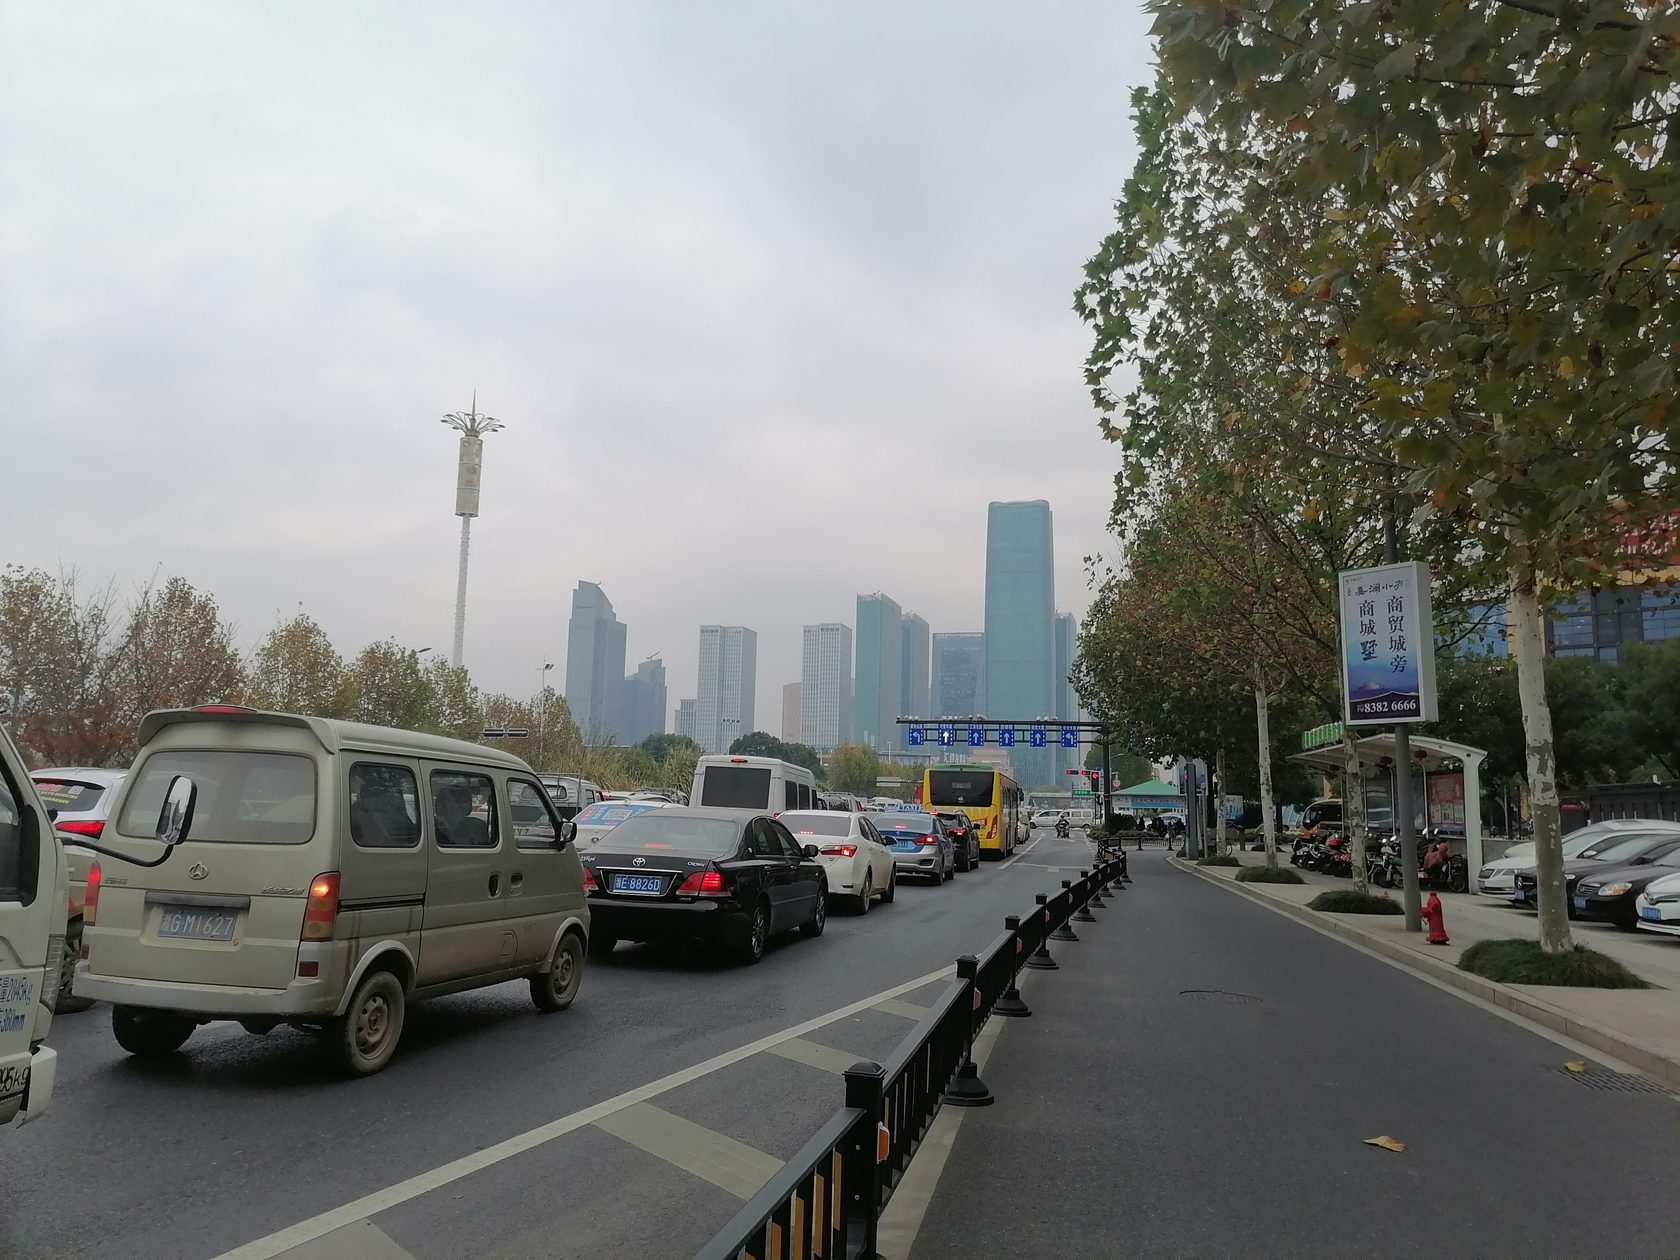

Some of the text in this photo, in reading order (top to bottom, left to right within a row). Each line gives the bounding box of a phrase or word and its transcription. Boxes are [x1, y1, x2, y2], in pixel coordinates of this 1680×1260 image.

[1358, 600, 1378, 662] 商城墅
[1386, 596, 1408, 674] 商贸城旁
[1364, 701, 1389, 713] 8382
[1391, 699, 1416, 711] 6666
